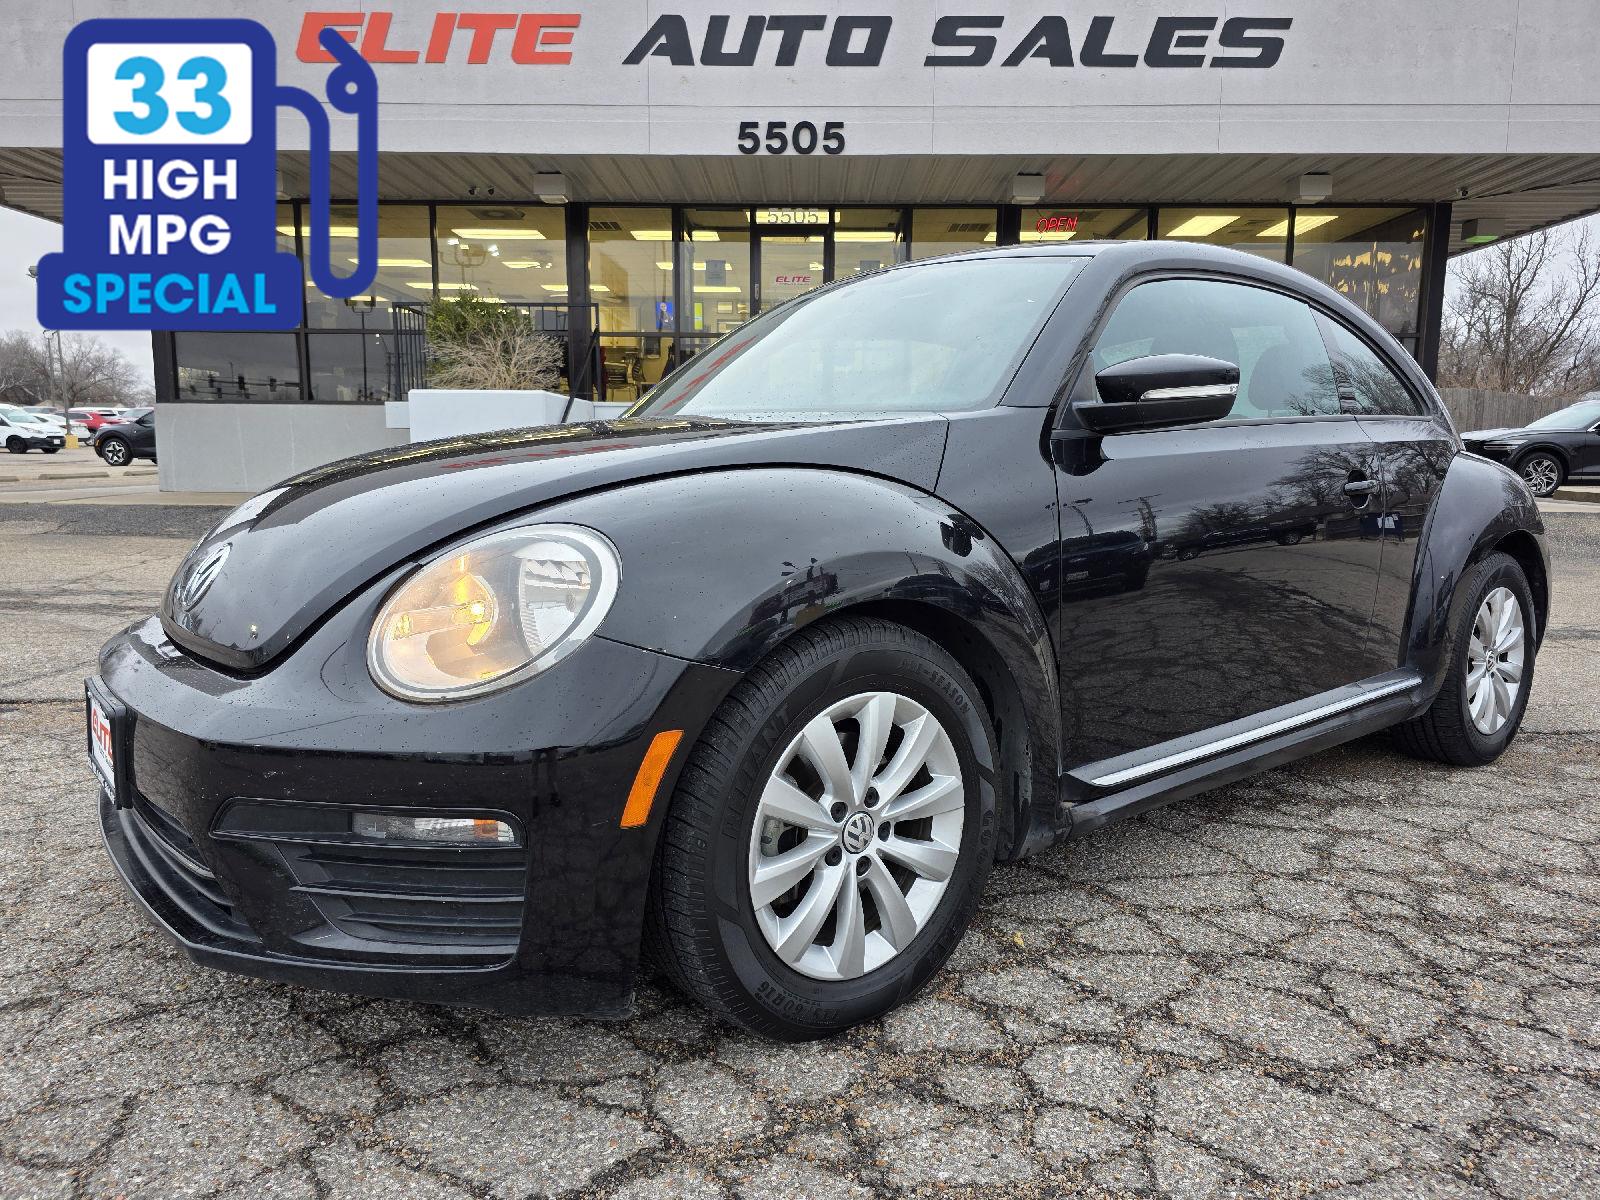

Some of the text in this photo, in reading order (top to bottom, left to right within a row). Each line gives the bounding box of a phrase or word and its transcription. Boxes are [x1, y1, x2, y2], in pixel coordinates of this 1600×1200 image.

[296, 12, 1292, 68] ELITE AUTO SALES
[738, 121, 846, 154] 5505
[767, 208, 818, 224] 5505
[1036, 216, 1078, 233] OPEN
